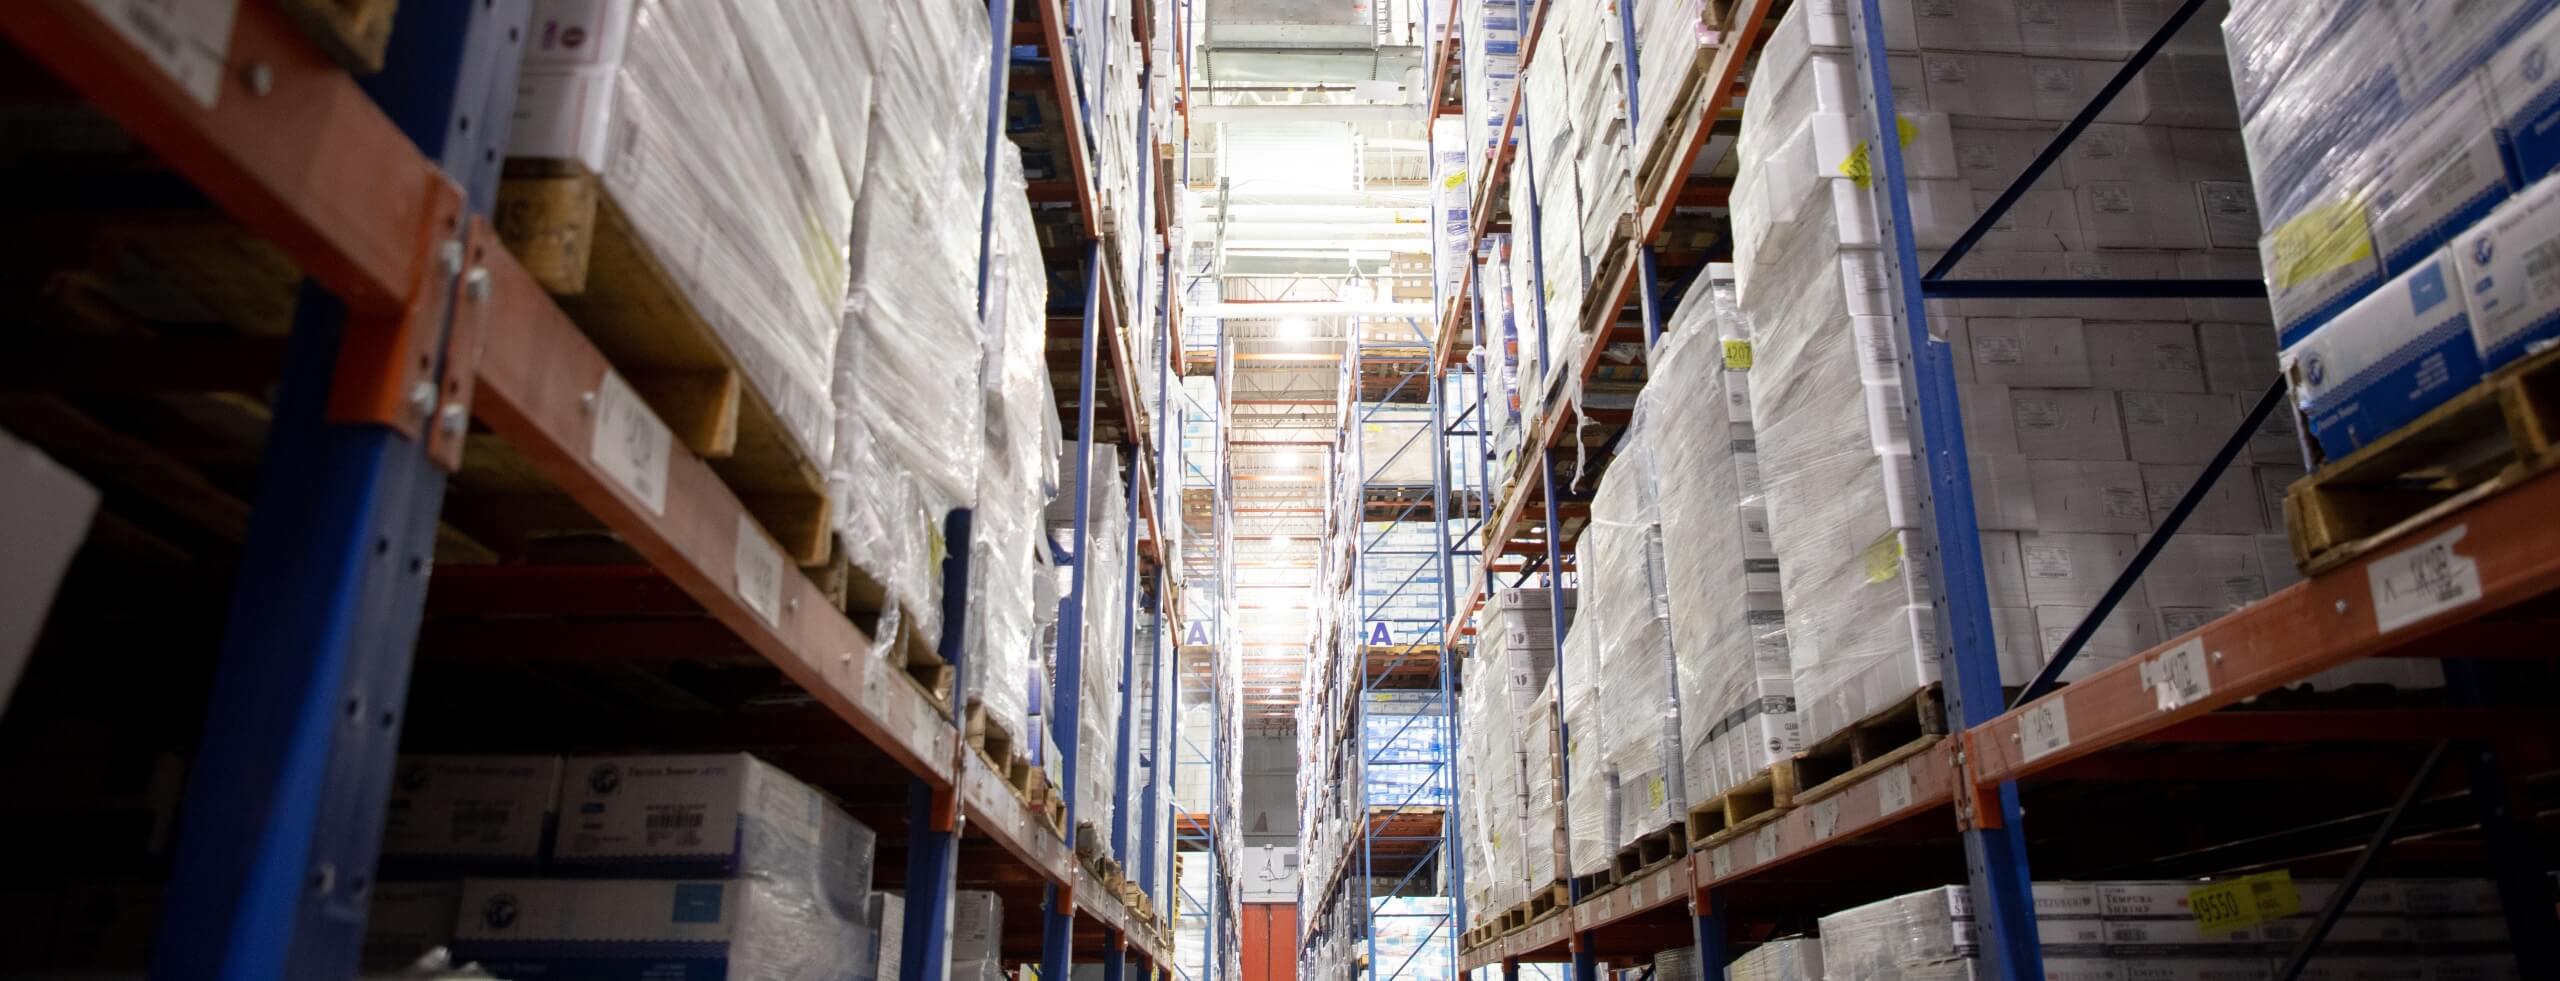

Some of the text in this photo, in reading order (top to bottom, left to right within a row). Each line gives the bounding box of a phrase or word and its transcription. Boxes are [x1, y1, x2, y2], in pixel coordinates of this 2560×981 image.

[1187, 620, 1209, 645] A
[1370, 622, 1393, 645] A
[2192, 890, 2239, 923] 49550
